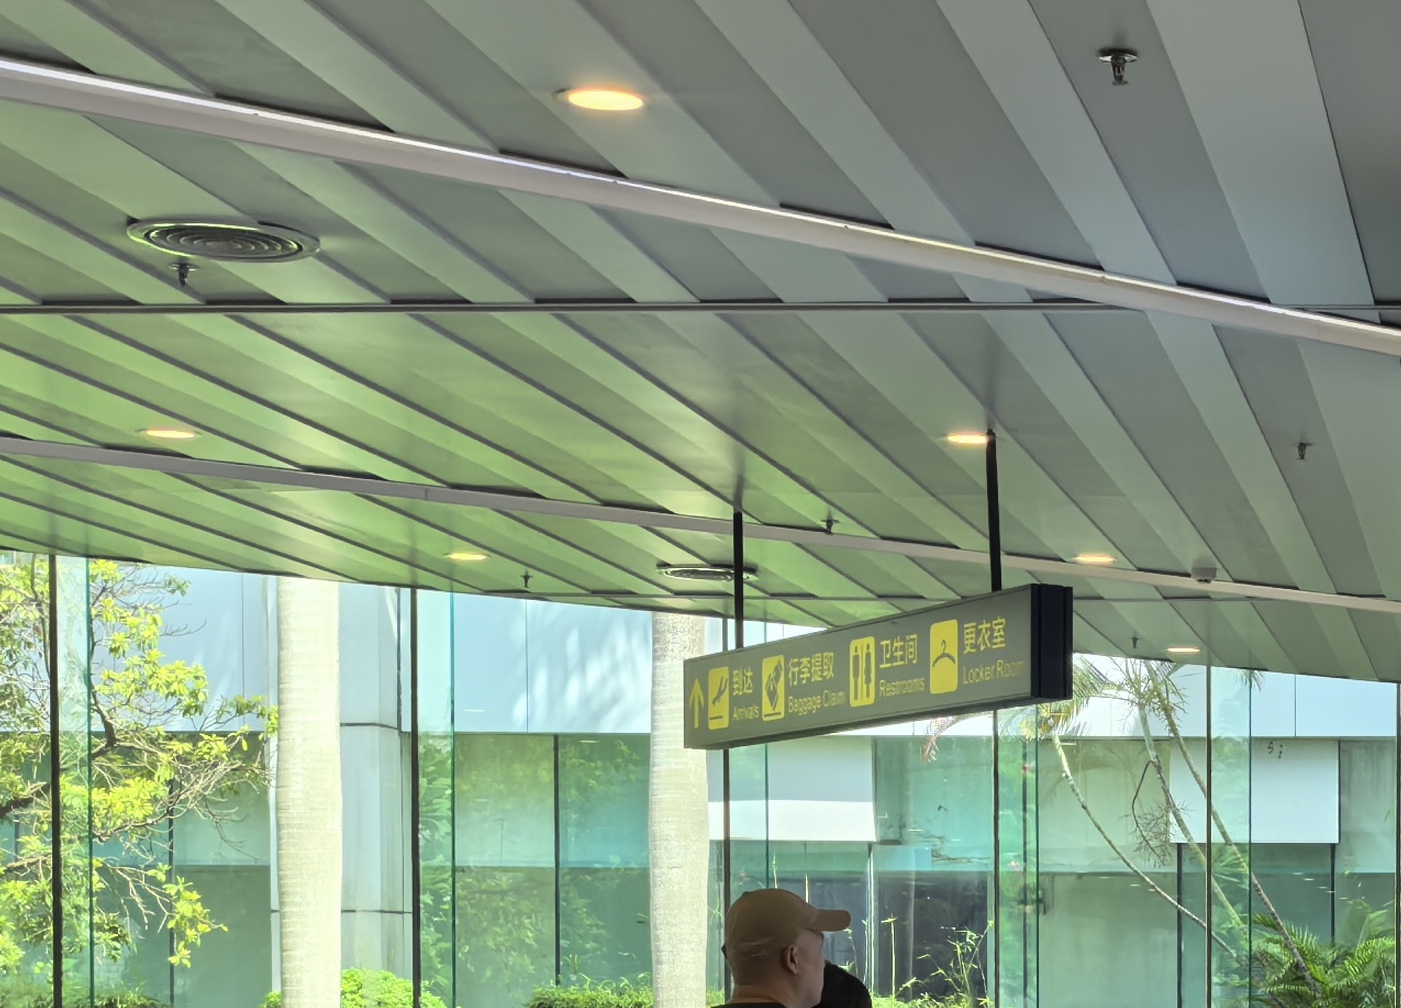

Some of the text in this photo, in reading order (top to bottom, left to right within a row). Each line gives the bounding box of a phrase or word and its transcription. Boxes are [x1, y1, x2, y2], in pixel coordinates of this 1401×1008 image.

[963, 616, 1006, 654] 更衣室
[879, 634, 917, 668] 卫生间
[732, 666, 753, 696] 到达
[788, 652, 834, 687] 行李提取
[963, 659, 1026, 684] Locker Room
[879, 677, 925, 697] Restrooms
[732, 704, 760, 721] Arrivals
[787, 690, 845, 716] Baggage Claim
